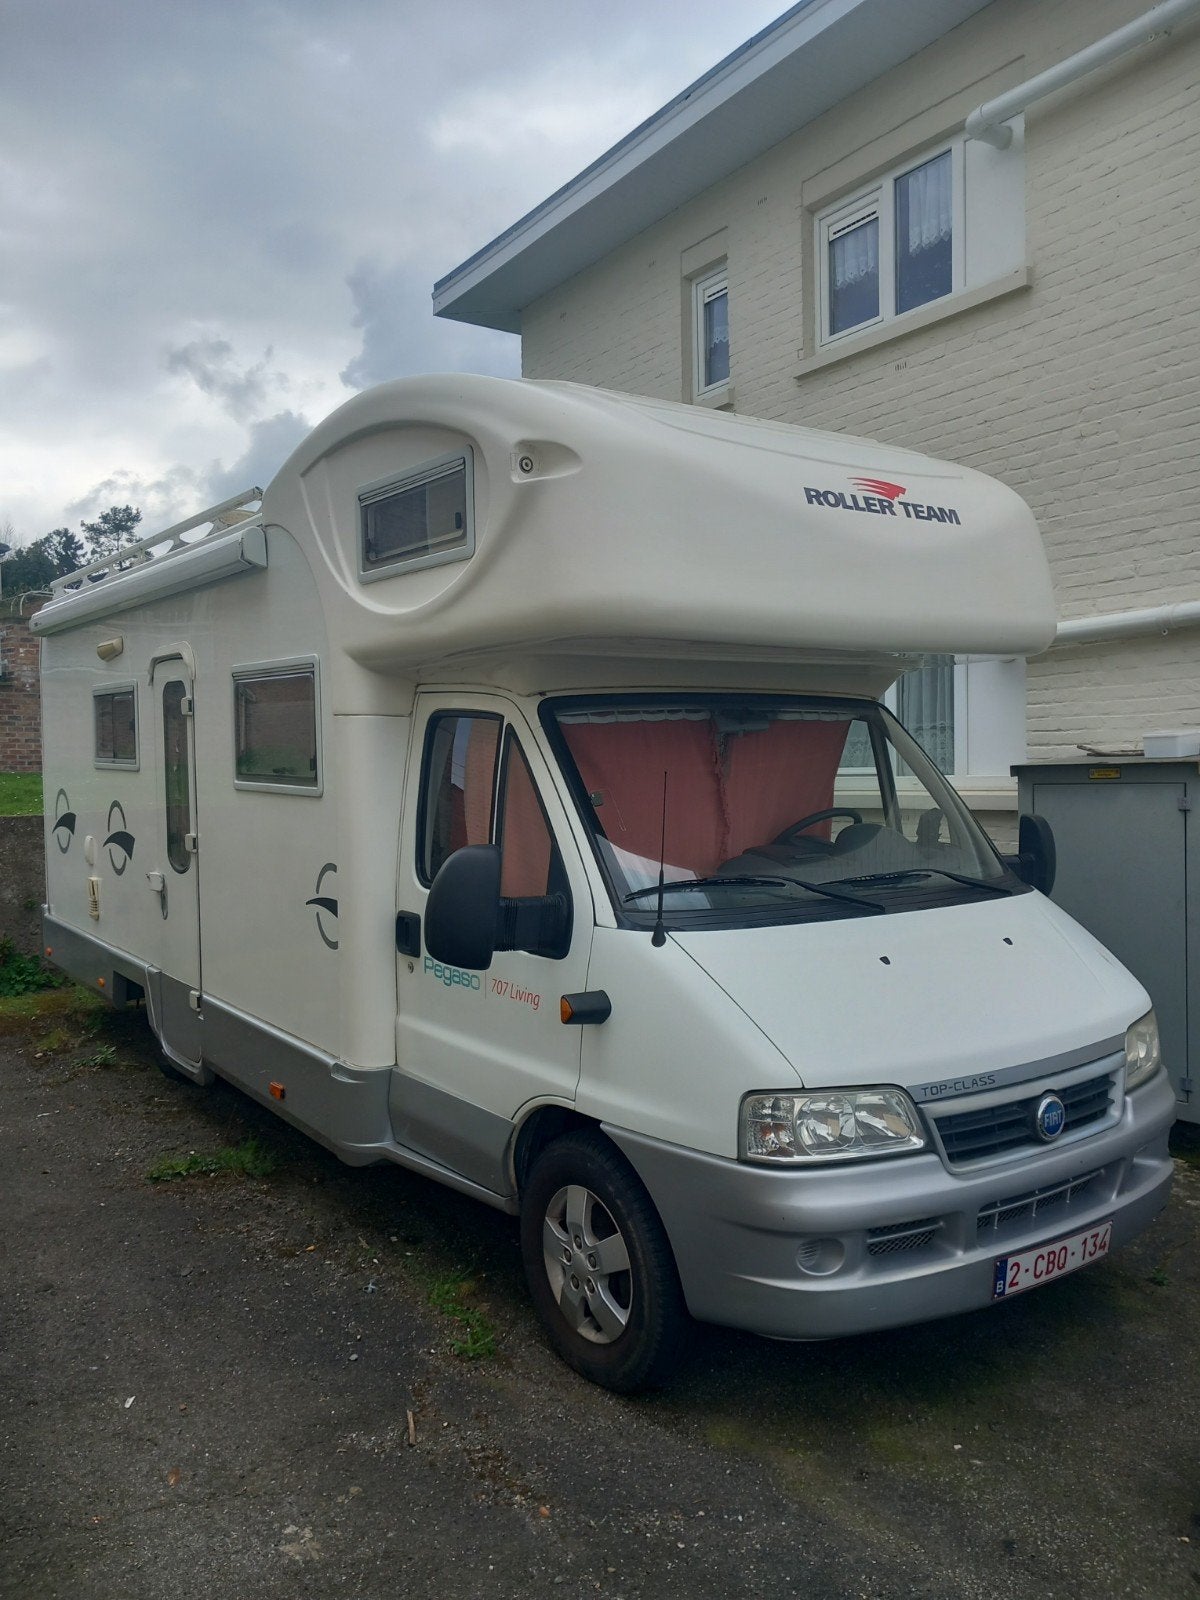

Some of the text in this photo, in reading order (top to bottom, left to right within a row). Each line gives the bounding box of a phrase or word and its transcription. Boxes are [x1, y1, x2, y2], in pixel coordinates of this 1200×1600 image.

[803, 486, 962, 526] ROLLER TEAM
[423, 955, 481, 991] Pegaso
[491, 978, 541, 1011] 707 Living
[920, 1074, 996, 1098] TOP-CLASS
[1044, 1109, 1063, 1129] FIAT
